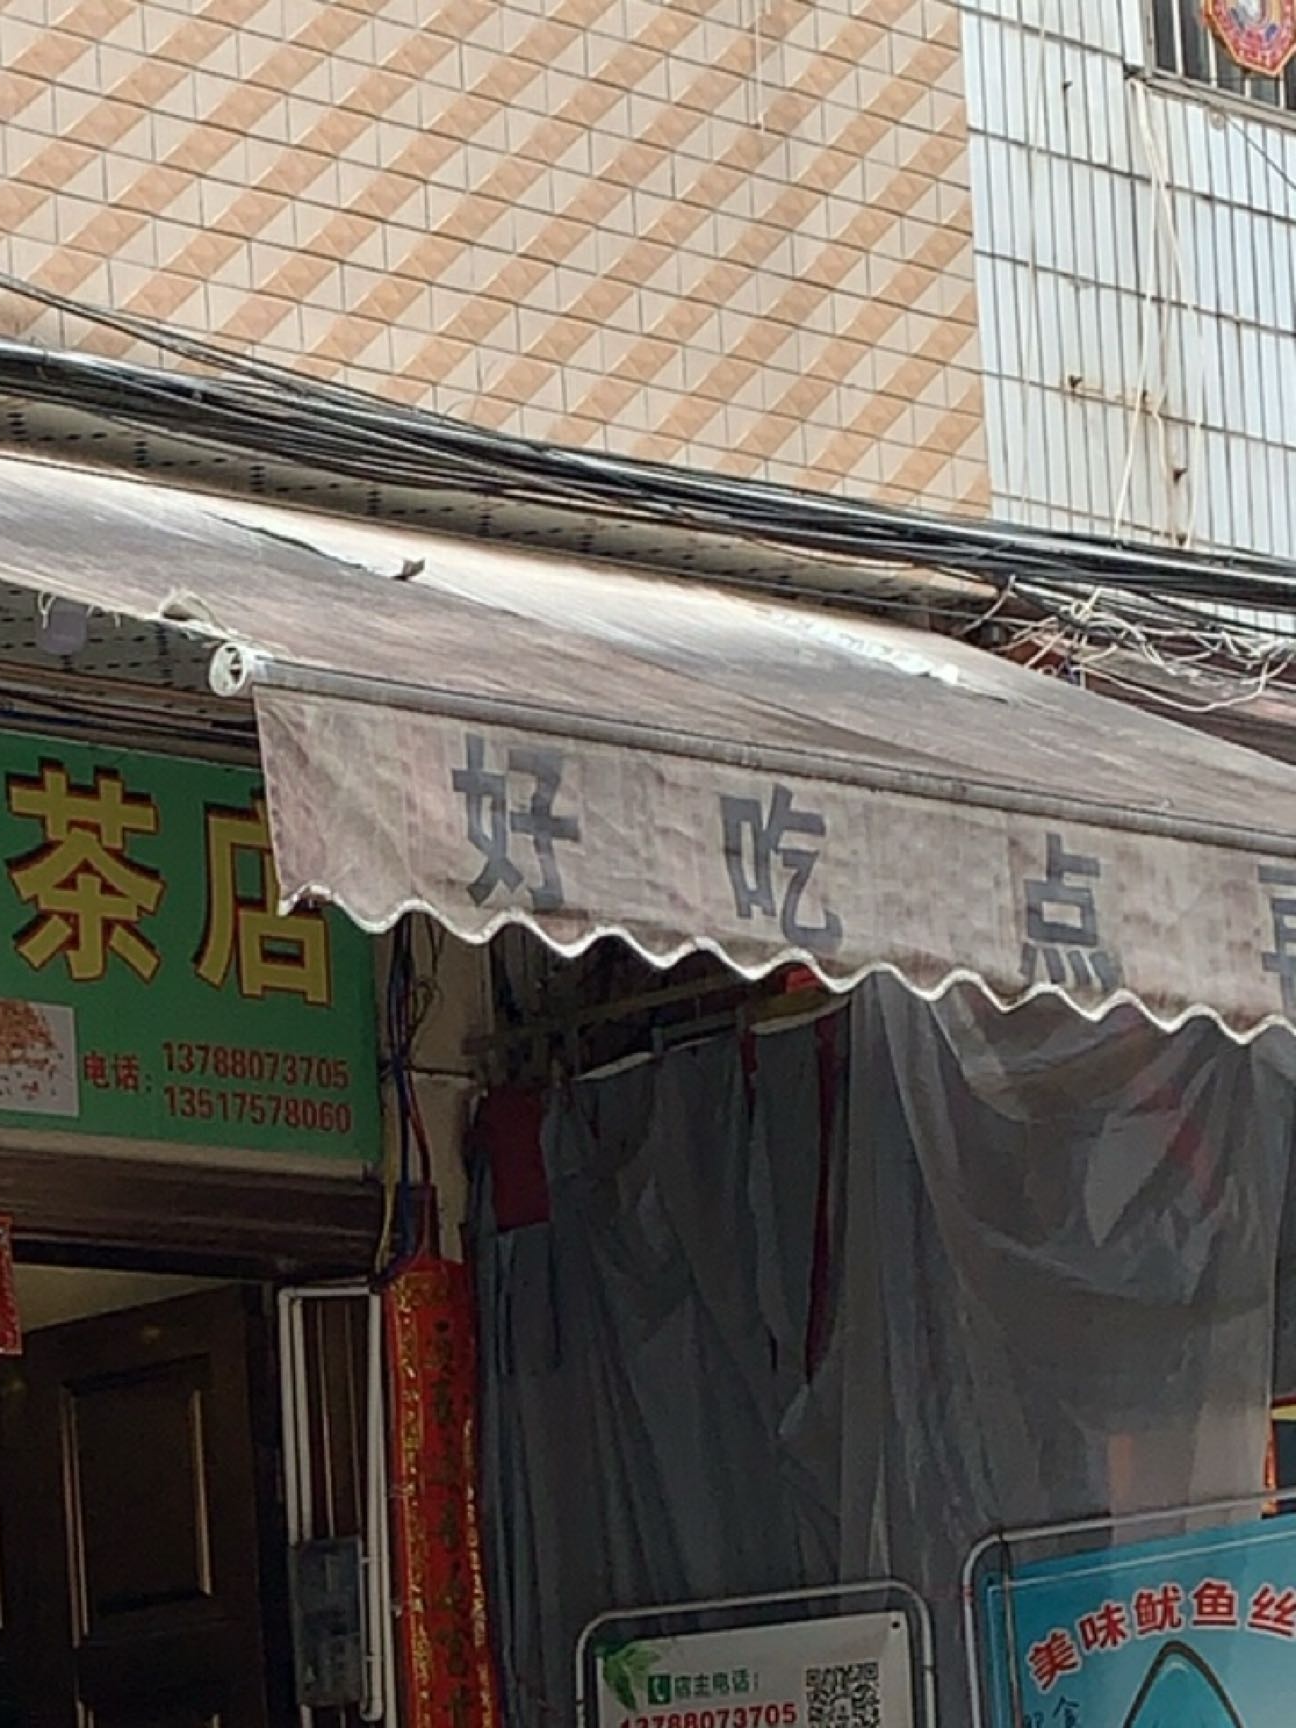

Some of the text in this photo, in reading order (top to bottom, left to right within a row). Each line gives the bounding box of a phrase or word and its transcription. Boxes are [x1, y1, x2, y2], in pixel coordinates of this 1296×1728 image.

[161, 1040, 351, 1092] 13788073705
[162, 1084, 353, 1136] 13517578060
[1028, 1582, 1296, 1691] 美味鱿鱼丝
